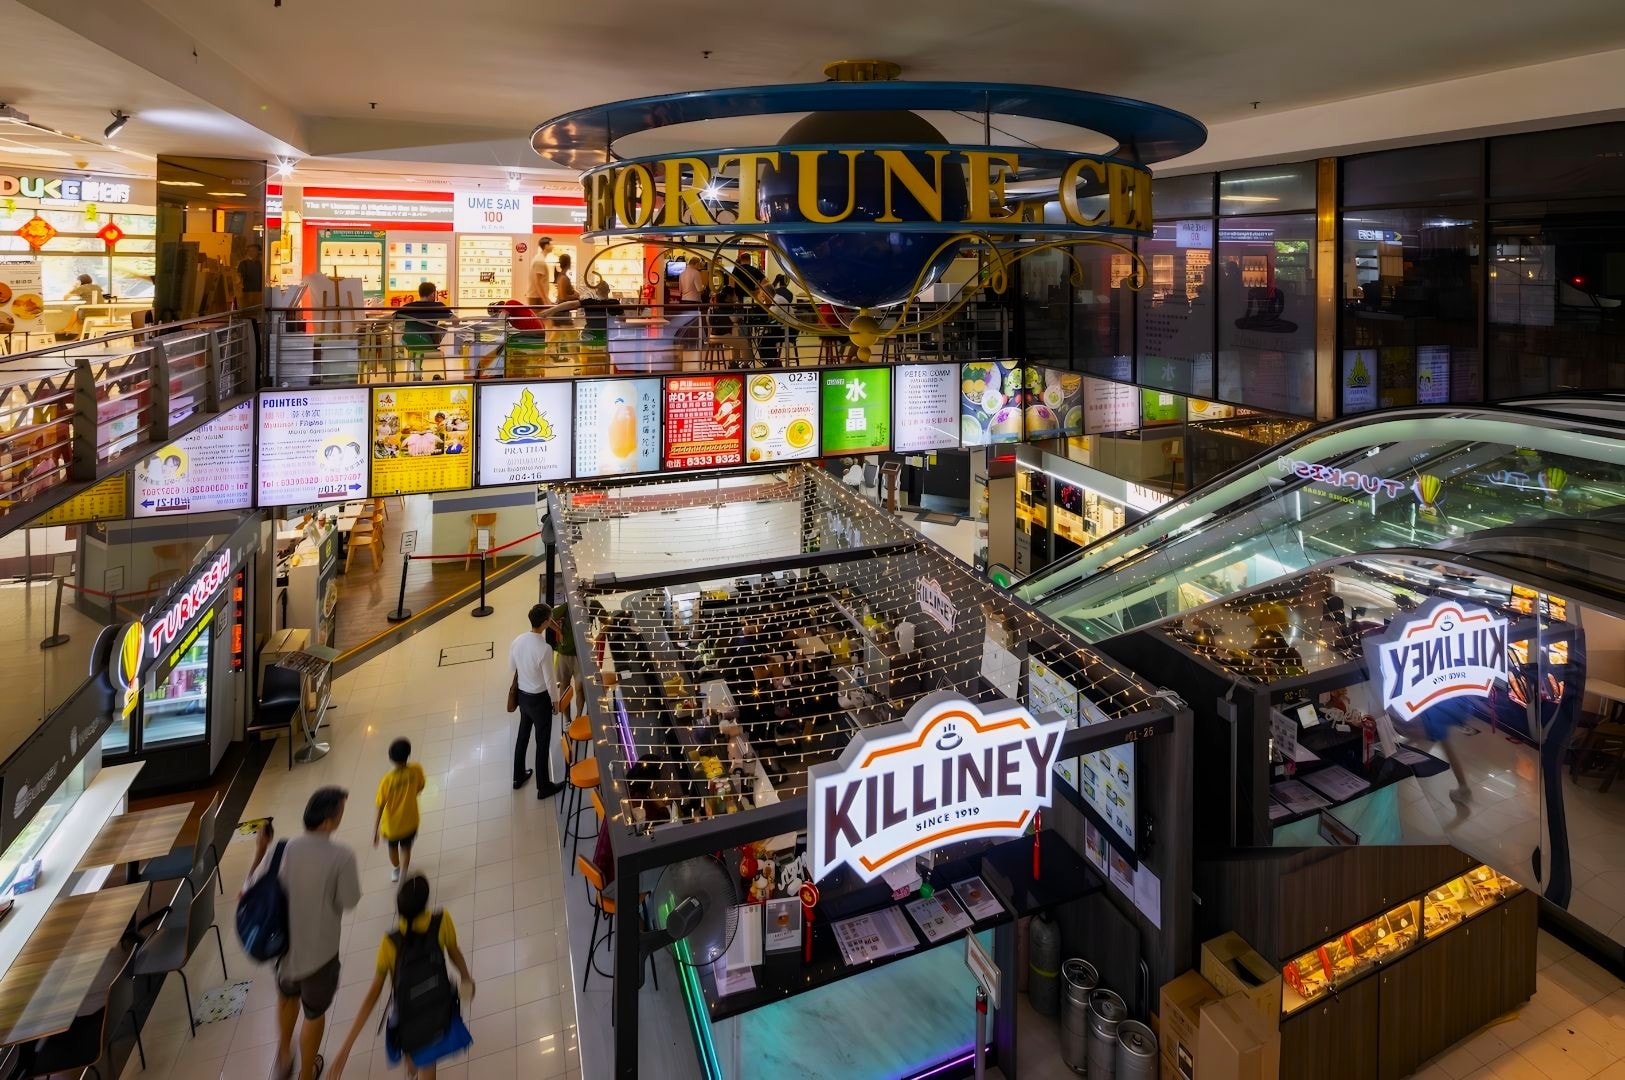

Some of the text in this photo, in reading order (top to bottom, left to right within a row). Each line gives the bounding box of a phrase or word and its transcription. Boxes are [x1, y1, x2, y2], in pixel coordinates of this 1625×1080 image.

[0, 175, 81, 200] DUKE
[585, 150, 1018, 231] FORTUNE
[468, 197, 520, 210] UME SAN
[484, 211, 503, 222] 100
[788, 372, 818, 382] 02-31
[668, 391, 714, 402] #01-29
[686, 456, 713, 466] 6333
[715, 454, 741, 464] 9323
[510, 472, 542, 481] #04-16
[262, 480, 274, 488] Tel
[318, 485, 347, 493] #01-21
[149, 548, 231, 659] TURKISH
[824, 731, 1059, 867] KILLINEY
[915, 806, 981, 832] SINCE 1919
